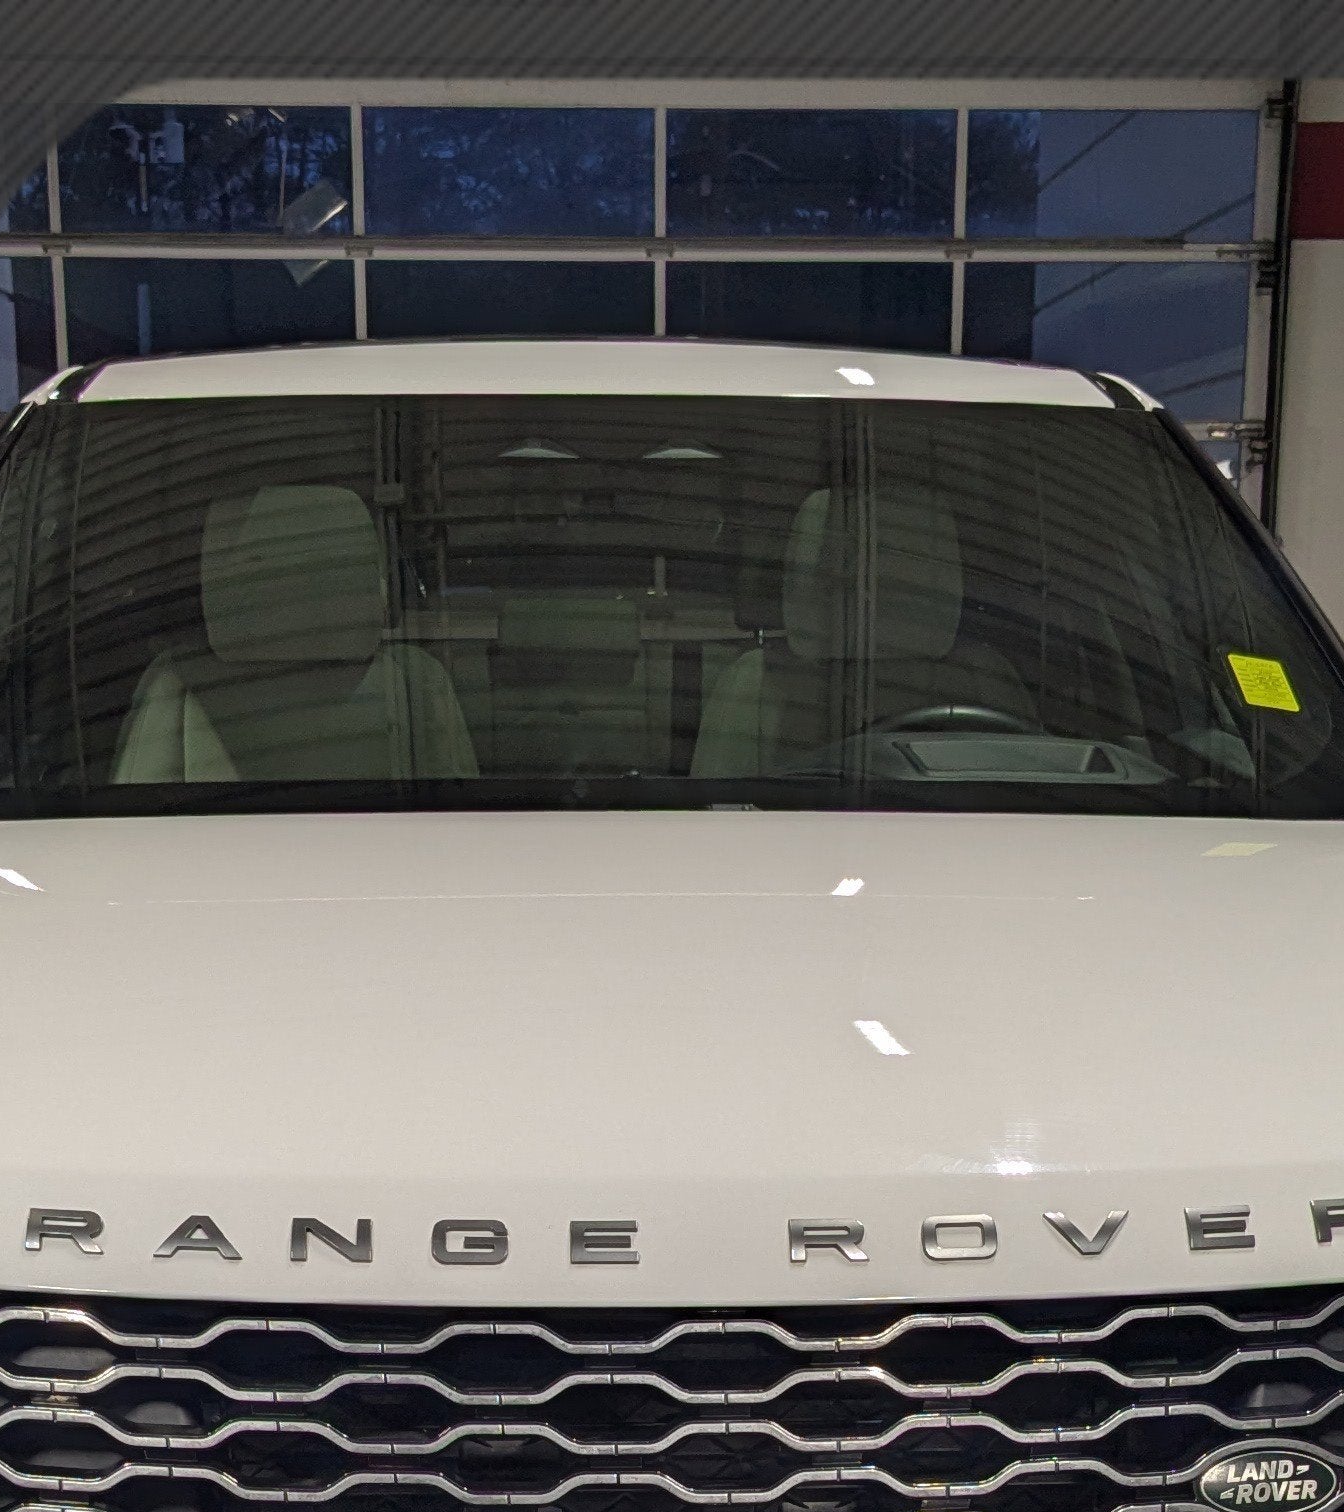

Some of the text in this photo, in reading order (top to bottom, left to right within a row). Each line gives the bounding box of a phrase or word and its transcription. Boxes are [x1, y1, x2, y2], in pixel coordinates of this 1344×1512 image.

[25, 1207, 641, 1265] RANGE
[1226, 1460, 1294, 1483] LAND
[1235, 1479, 1318, 1504] ROVER
